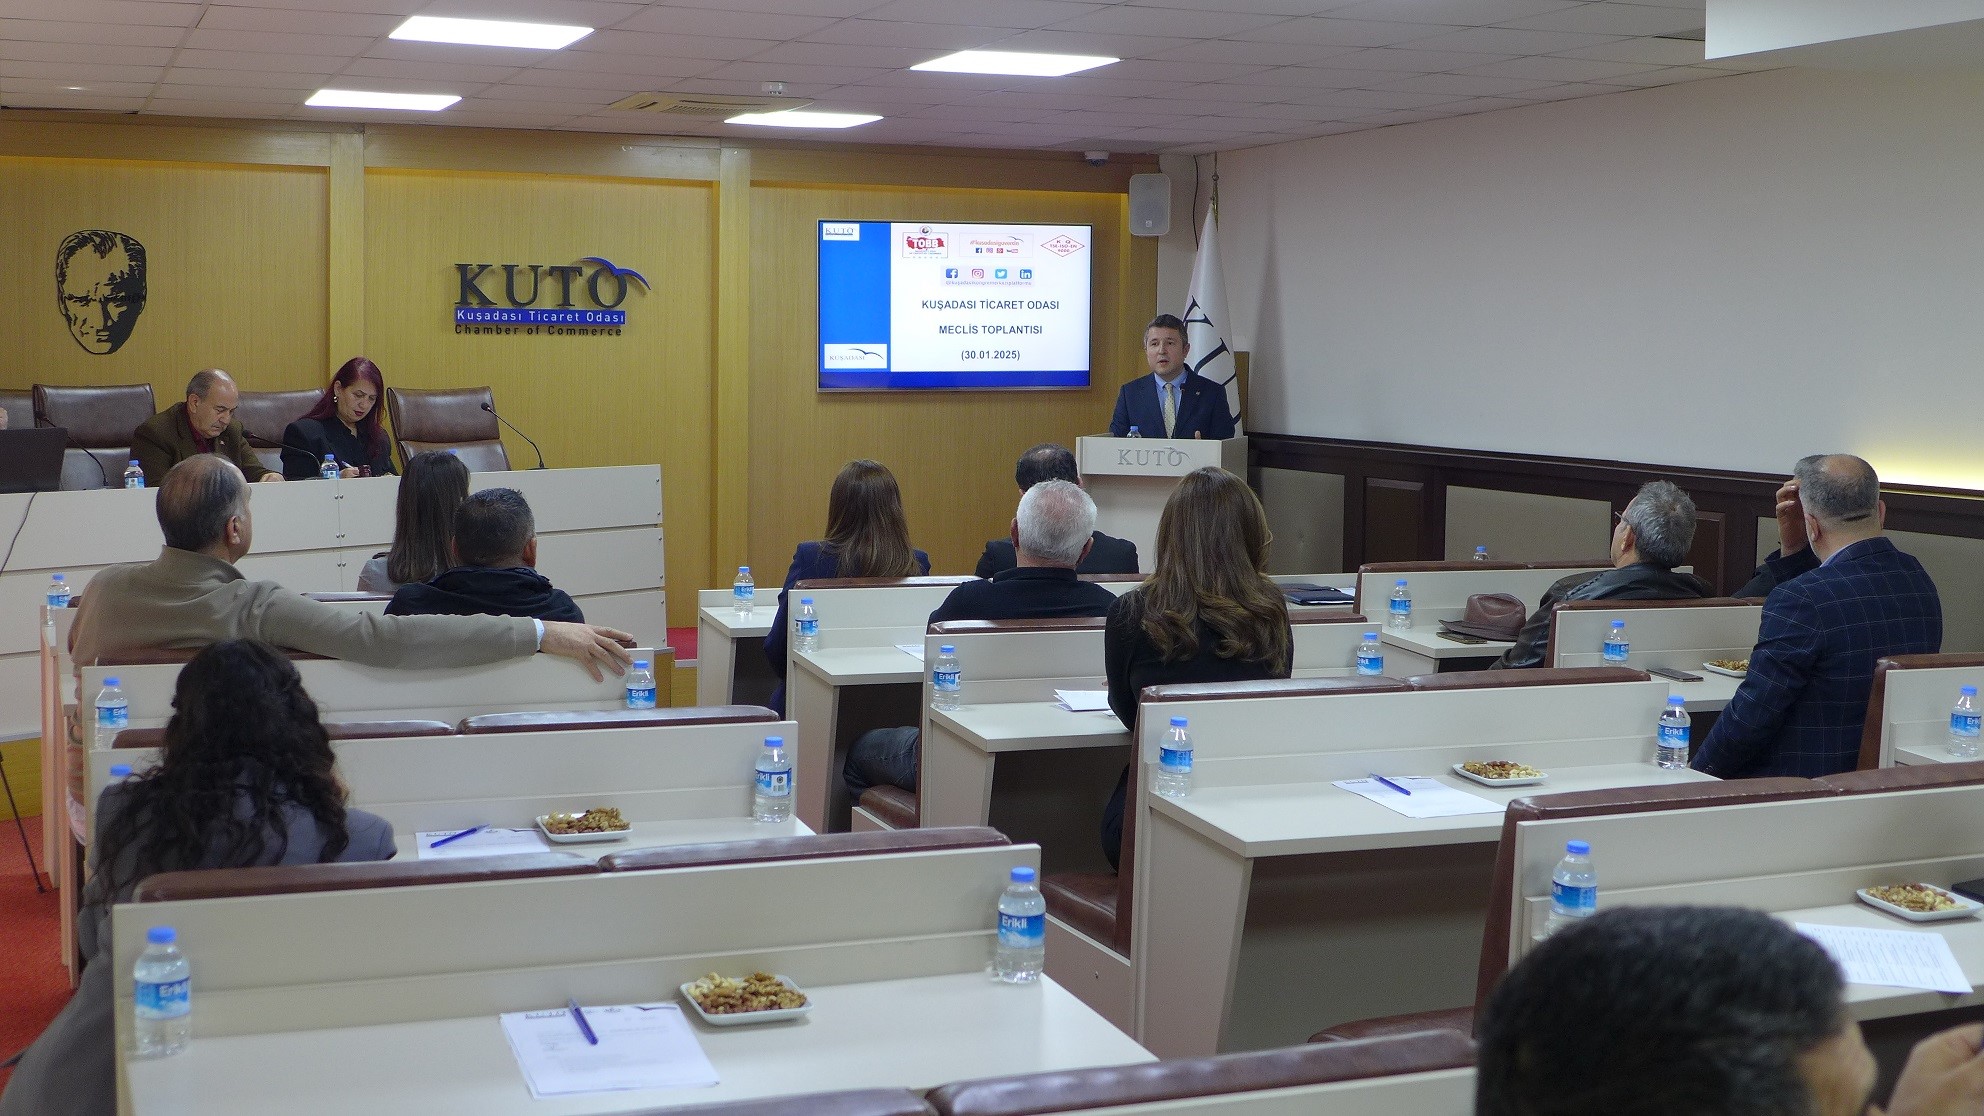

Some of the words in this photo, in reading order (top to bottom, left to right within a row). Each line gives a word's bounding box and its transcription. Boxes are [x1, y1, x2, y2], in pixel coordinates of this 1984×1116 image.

[913, 238, 938, 248] TOBB
[454, 263, 628, 309] KUTO
[922, 300, 976, 311] KUŞADASI
[980, 299, 1024, 310] TİCARET
[1027, 300, 1060, 310] ODASI
[457, 309, 523, 322] Kuşadası
[528, 310, 580, 322] Ticaret
[586, 311, 624, 323] Odası
[455, 324, 519, 335] Chamber
[527, 325, 540, 335] of
[548, 325, 622, 336] Commerce
[939, 324, 979, 335] MECLİS
[982, 325, 1043, 335] TOPLANTISI
[961, 350, 1021, 361] (30.01.2025)
[1117, 448, 1183, 467] KUTO
[631, 690, 649, 698] Erikli
[1665, 727, 1683, 736] Erikli
[1002, 915, 1027, 929] Erikli
